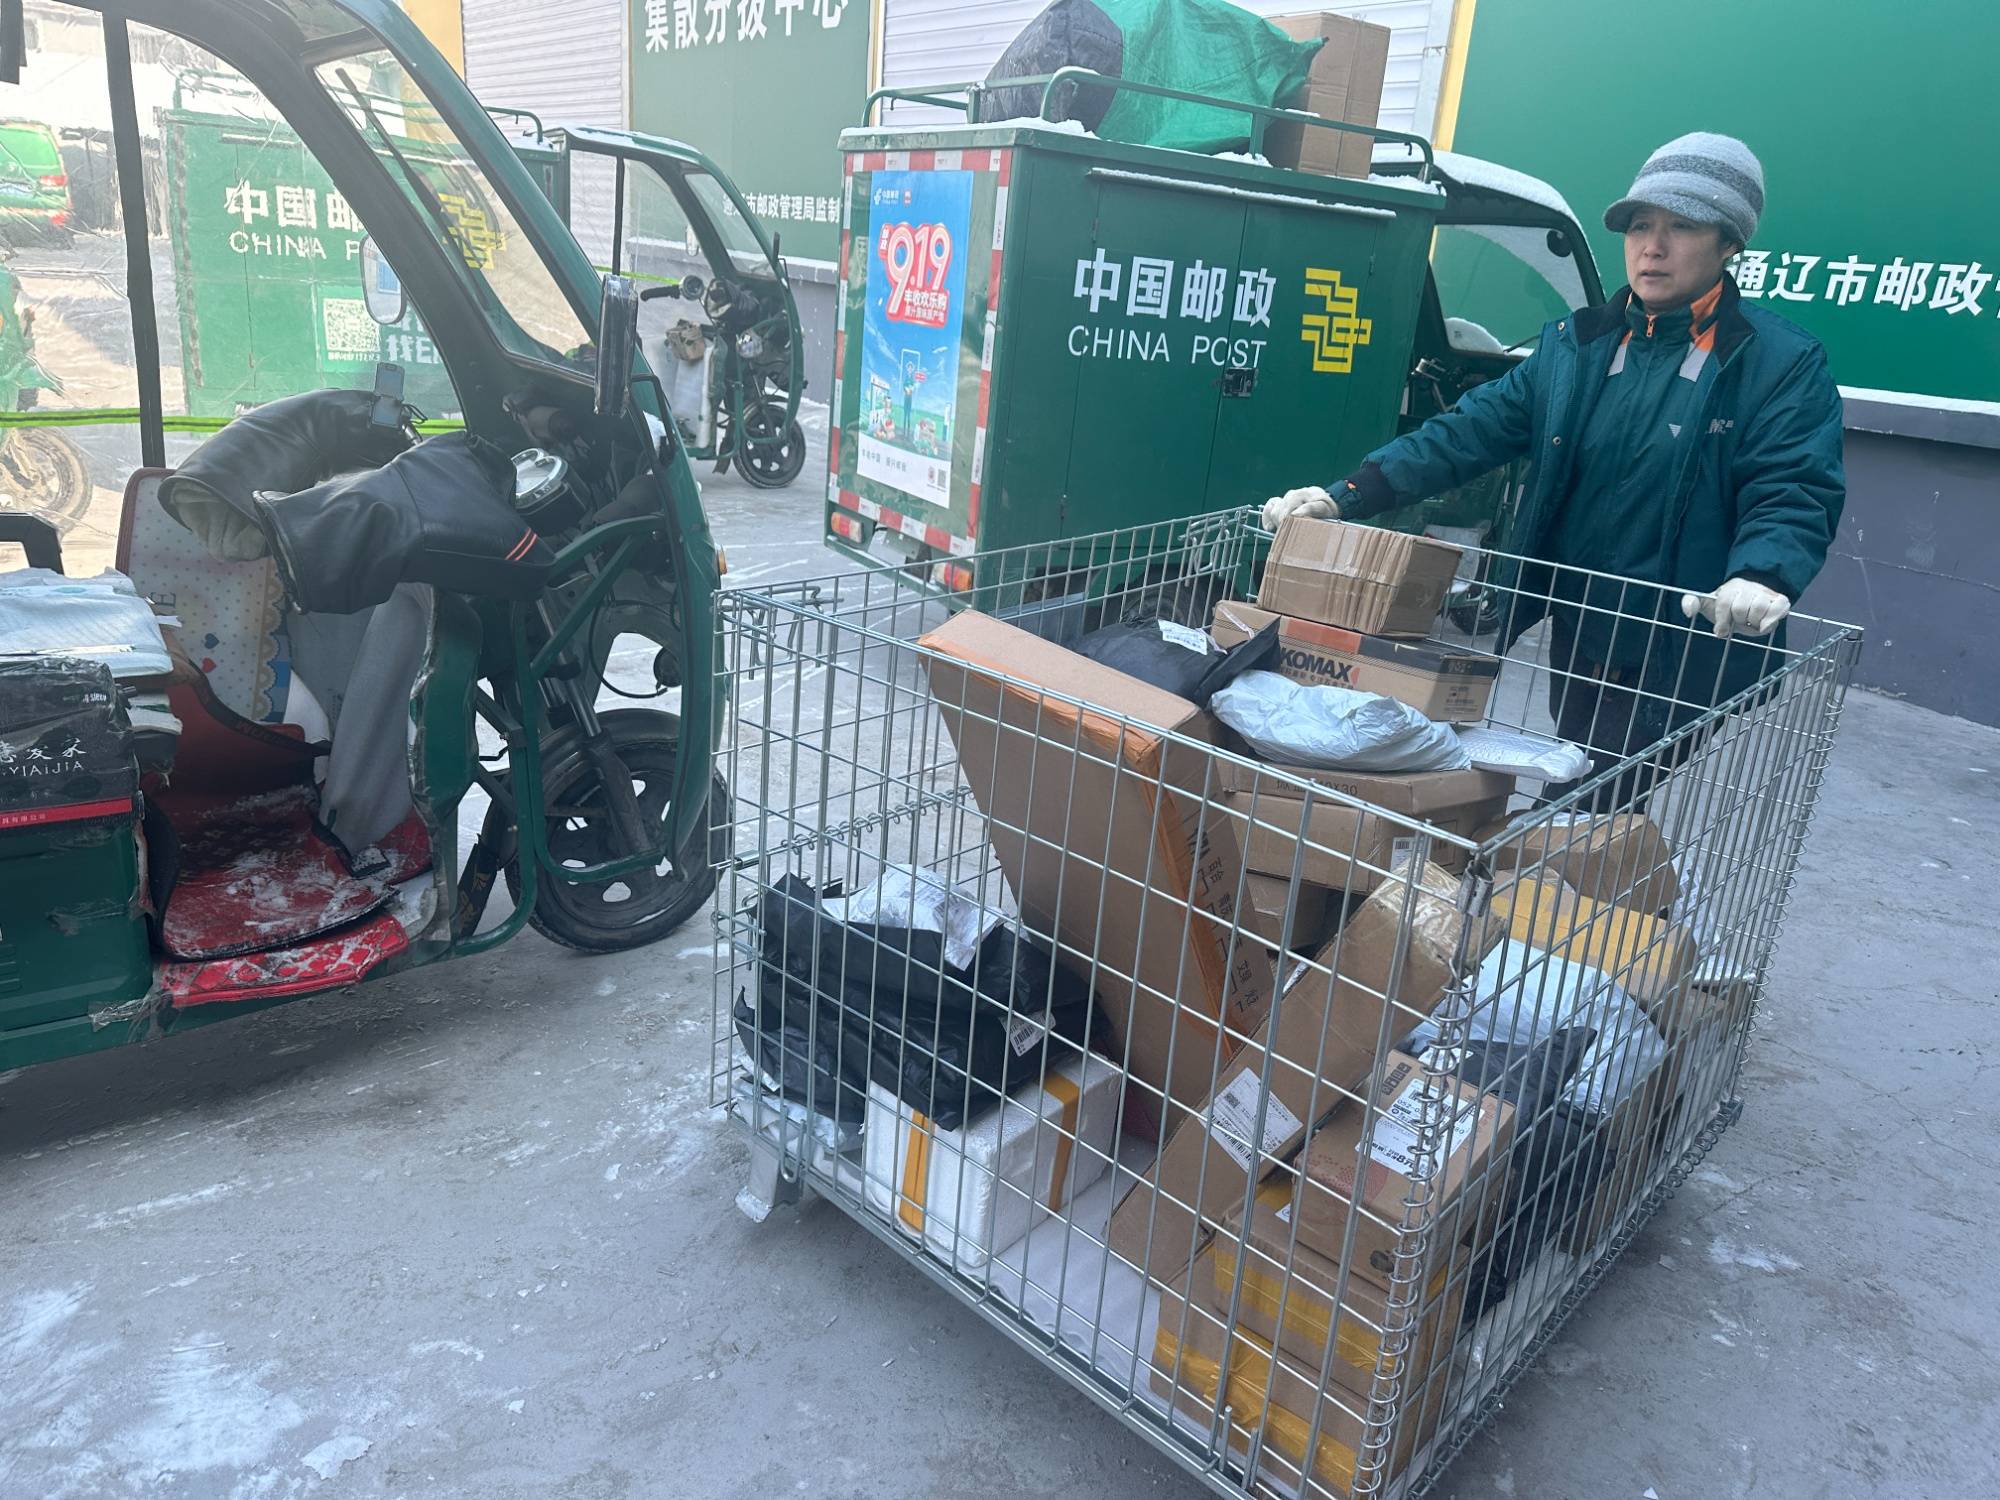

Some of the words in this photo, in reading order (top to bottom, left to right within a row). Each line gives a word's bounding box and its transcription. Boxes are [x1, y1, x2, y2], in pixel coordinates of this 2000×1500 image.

[229, 231, 327, 259] CHINA
[1073, 247, 1277, 329] 中国邮政
[1725, 249, 2000, 319] 通辽市邮政
[1067, 325, 1170, 362] CHINA
[1191, 335, 1267, 368] POST
[1281, 647, 1353, 682] KOMAX
